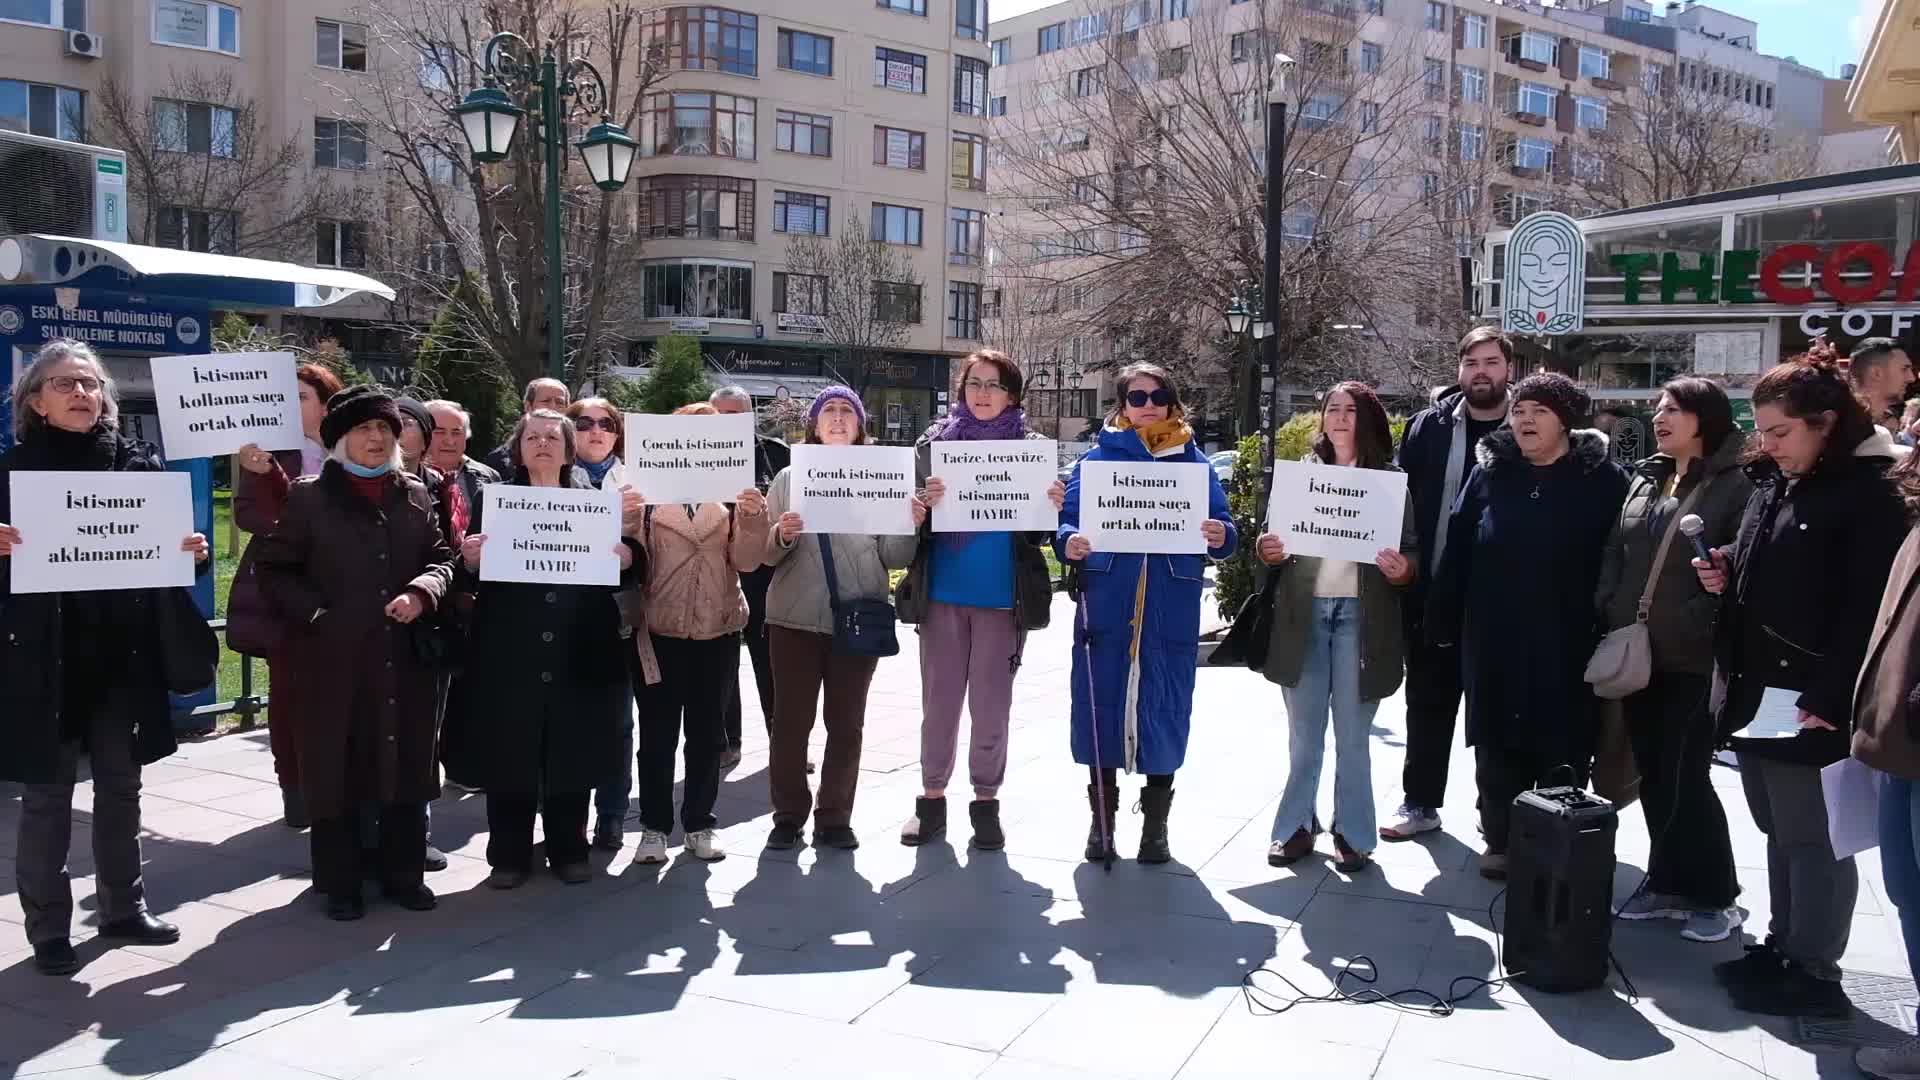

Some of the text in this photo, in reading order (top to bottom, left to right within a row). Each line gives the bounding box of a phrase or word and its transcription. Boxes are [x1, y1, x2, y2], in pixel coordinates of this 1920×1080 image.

[63, 308, 100, 324] GENEL
[103, 309, 173, 328] MÜDÜRLÜĞÜ
[41, 325, 58, 338] SU
[61, 323, 114, 343] YÜKLEME
[118, 330, 165, 345] NOKTASI
[193, 367, 268, 383] İstismarı
[179, 392, 285, 409] kollama suça
[188, 412, 285, 433] ortak olma!
[642, 438, 744, 452] Çocuk istismarı
[639, 456, 748, 471] insanlık suçudur
[807, 468, 905, 482] Çocuk istismarı
[975, 470, 1012, 485] çocuk
[1113, 471, 1177, 488] İstismarı
[804, 487, 908, 501] insanlık suçudur
[1309, 477, 1368, 498] İstismar
[66, 490, 146, 509] İstismar
[959, 490, 1030, 501] istismarına
[1098, 495, 1192, 512] kollama suça
[971, 508, 1017, 520] HAYIR!
[1314, 505, 1361, 519] suçtur
[77, 521, 139, 539] suçtur
[532, 520, 573, 534] çocuk
[1101, 517, 1185, 531] ortak olma!
[1291, 521, 1375, 541] aklanamaz!
[512, 538, 591, 553] istismarına
[48, 545, 161, 563] aklanamaz!
[525, 560, 577, 572] HAYIR!
